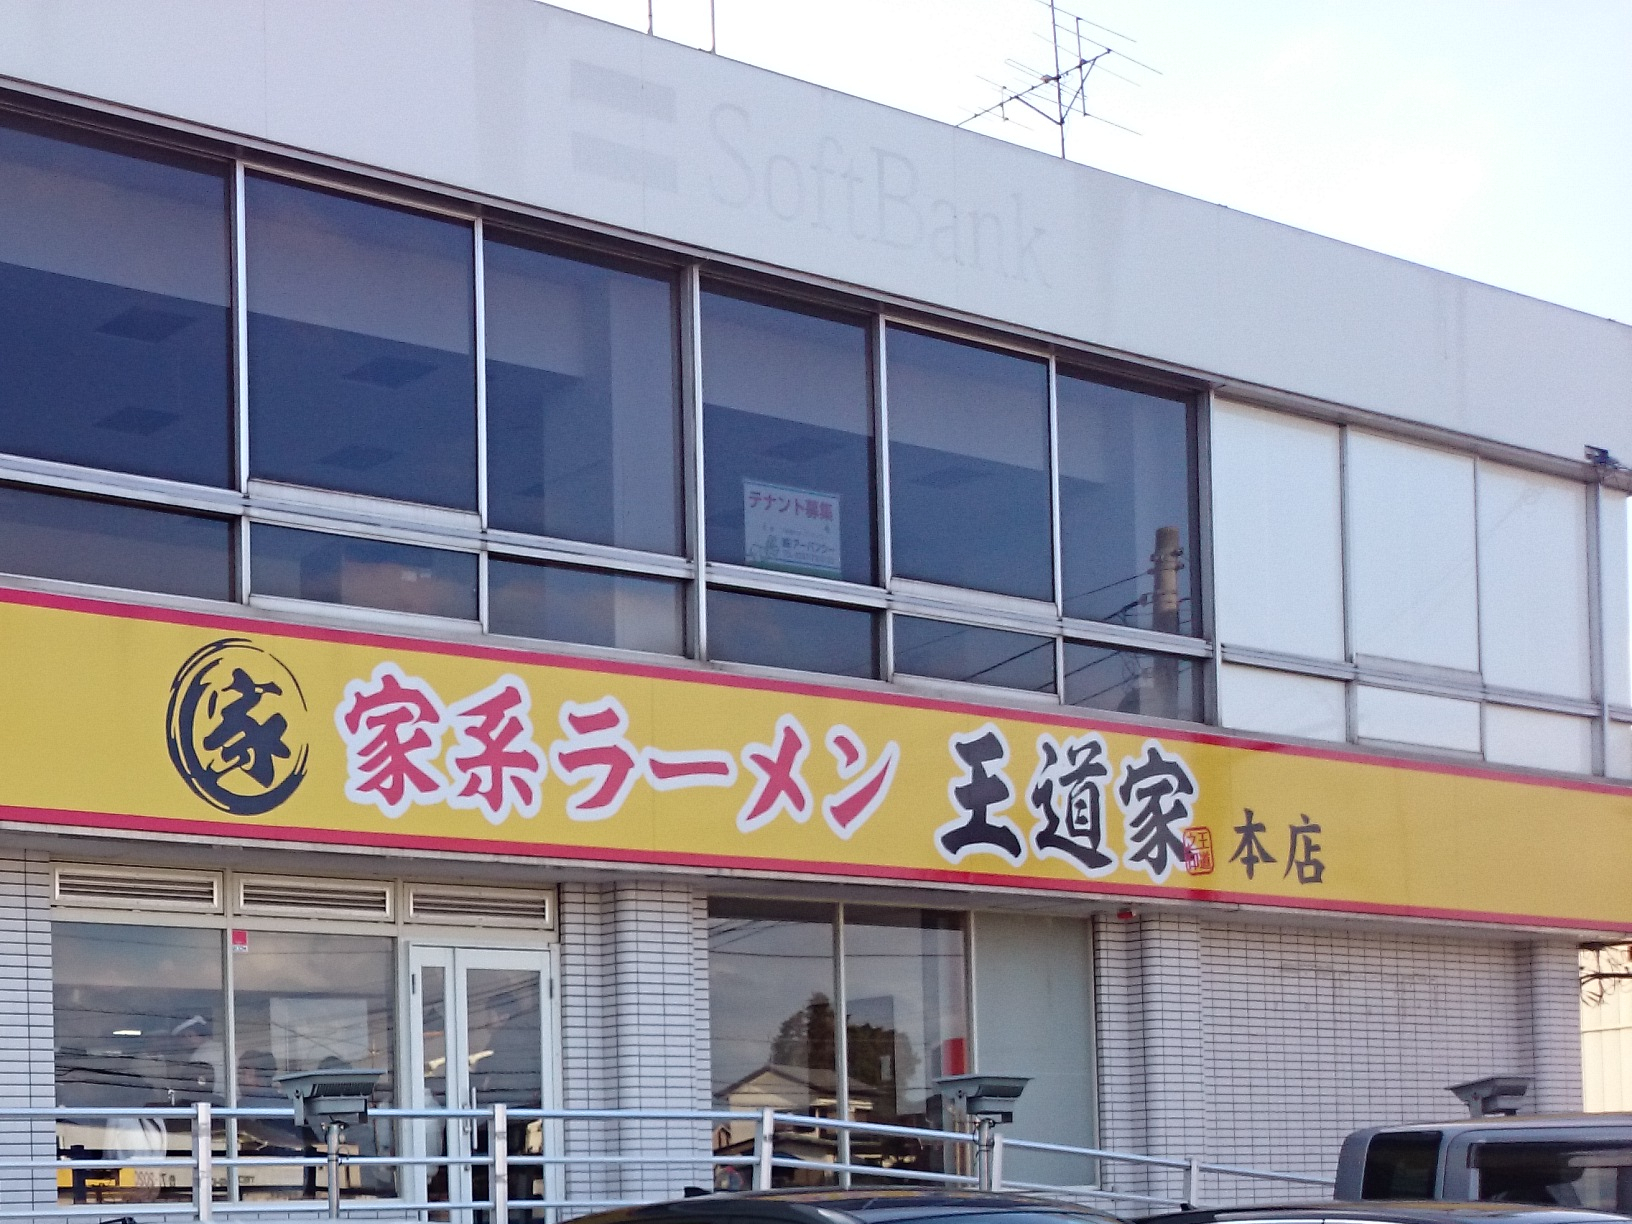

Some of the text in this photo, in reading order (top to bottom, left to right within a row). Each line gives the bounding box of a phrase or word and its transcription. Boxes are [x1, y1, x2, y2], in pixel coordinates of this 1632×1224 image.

[709, 101, 1052, 289] SoftBank
[344, 672, 1195, 876] 家系ラーメン 王道家
[1228, 807, 1326, 885] 本店
